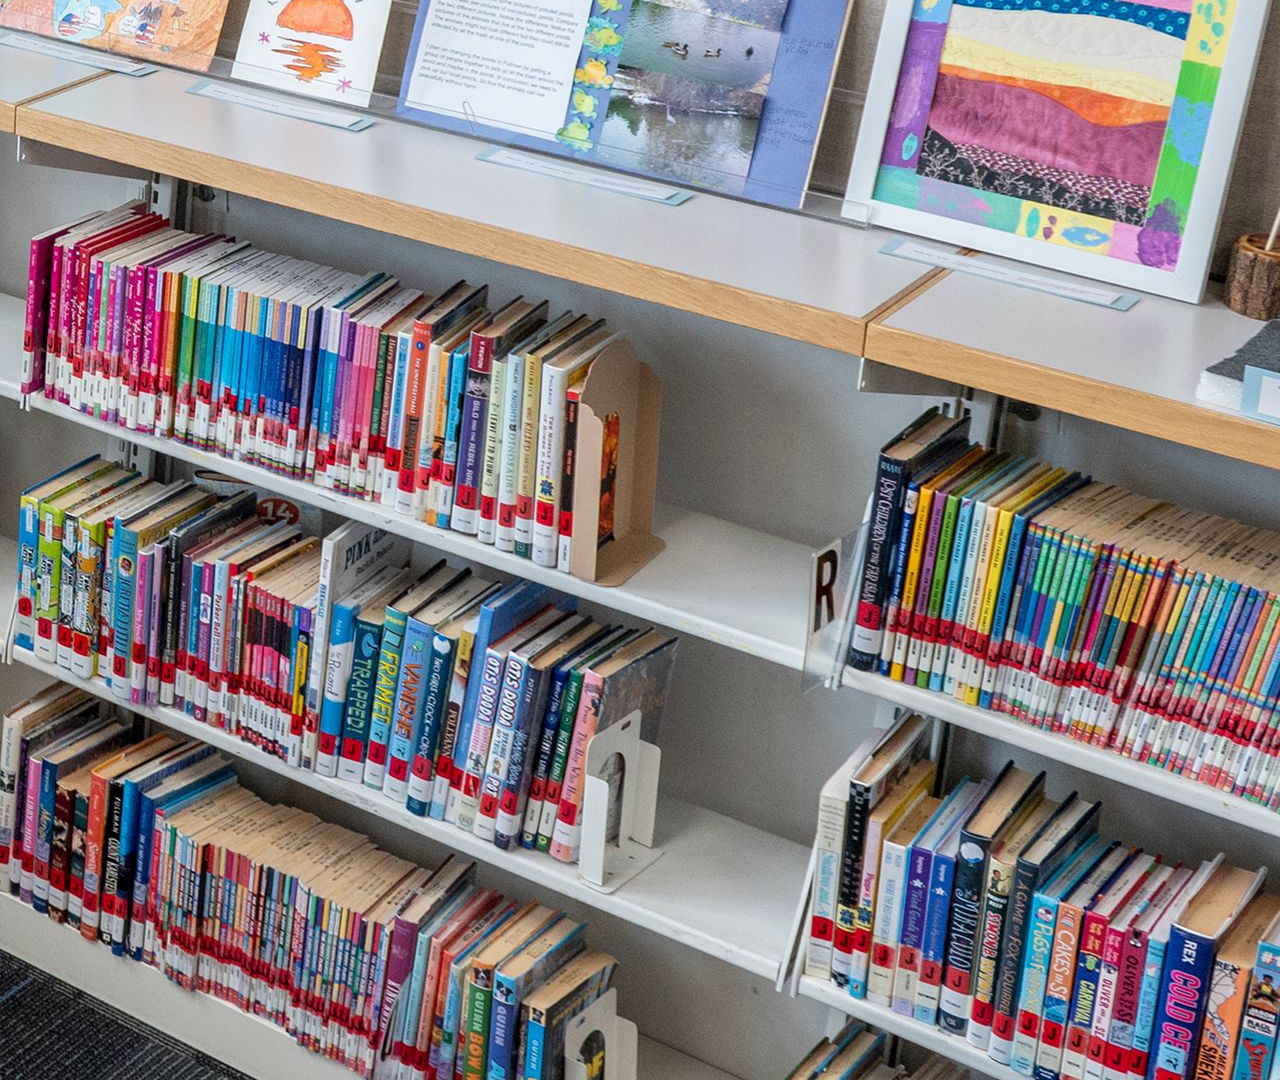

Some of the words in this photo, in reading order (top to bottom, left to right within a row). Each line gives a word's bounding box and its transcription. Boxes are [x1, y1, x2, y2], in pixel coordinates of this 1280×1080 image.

[262, 501, 293, 521] 14
[345, 532, 372, 570] PINK
[813, 549, 838, 633] R
[373, 653, 400, 725] FRAMED
[482, 657, 502, 687] OTIS
[505, 658, 521, 690] OTIS
[347, 658, 372, 738] TRAPPED!
[477, 688, 495, 727] DOODA
[498, 691, 517, 728] DOODA
[1052, 929, 1076, 975] CAKES
[1181, 940, 1198, 966] REX
[473, 992, 484, 1033] QUINN
[1074, 979, 1095, 1025] CARNIVAL
[1097, 977, 1113, 1012] OLIVER
[1166, 970, 1201, 1024] COLD
[495, 1006, 506, 1047] QUINN
[468, 1032, 484, 1070] BOW
